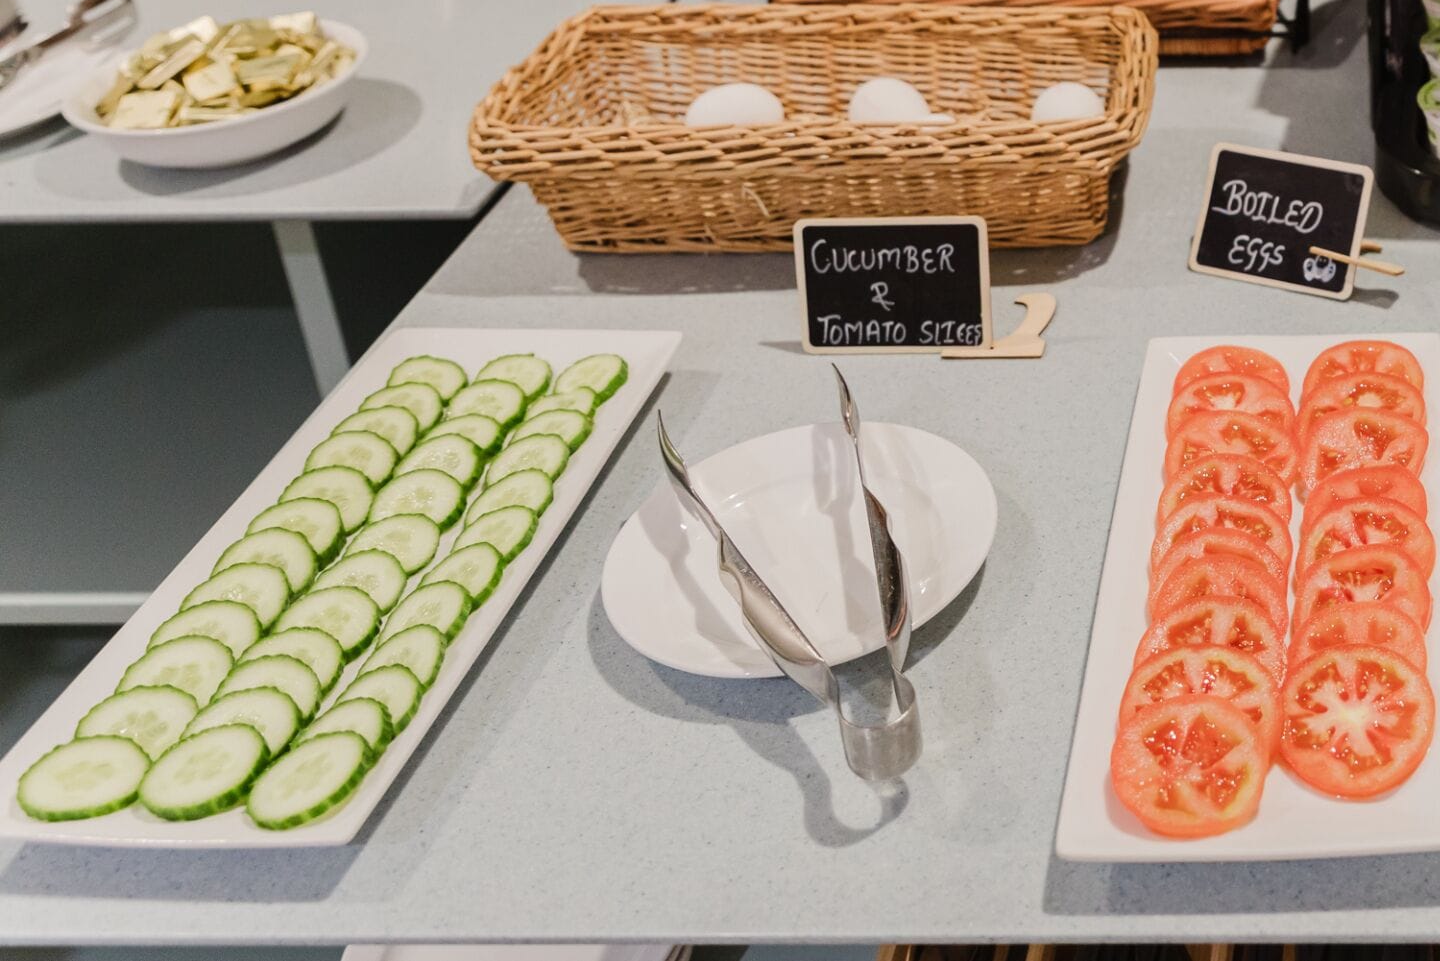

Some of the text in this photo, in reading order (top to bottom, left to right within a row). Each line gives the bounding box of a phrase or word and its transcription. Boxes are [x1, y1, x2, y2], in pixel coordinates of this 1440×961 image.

[1211, 179, 1323, 234] BOILED
[810, 238, 956, 274] CUCUMBER
[1228, 234, 1286, 272] EGGS
[817, 314, 907, 345] TOMATO
